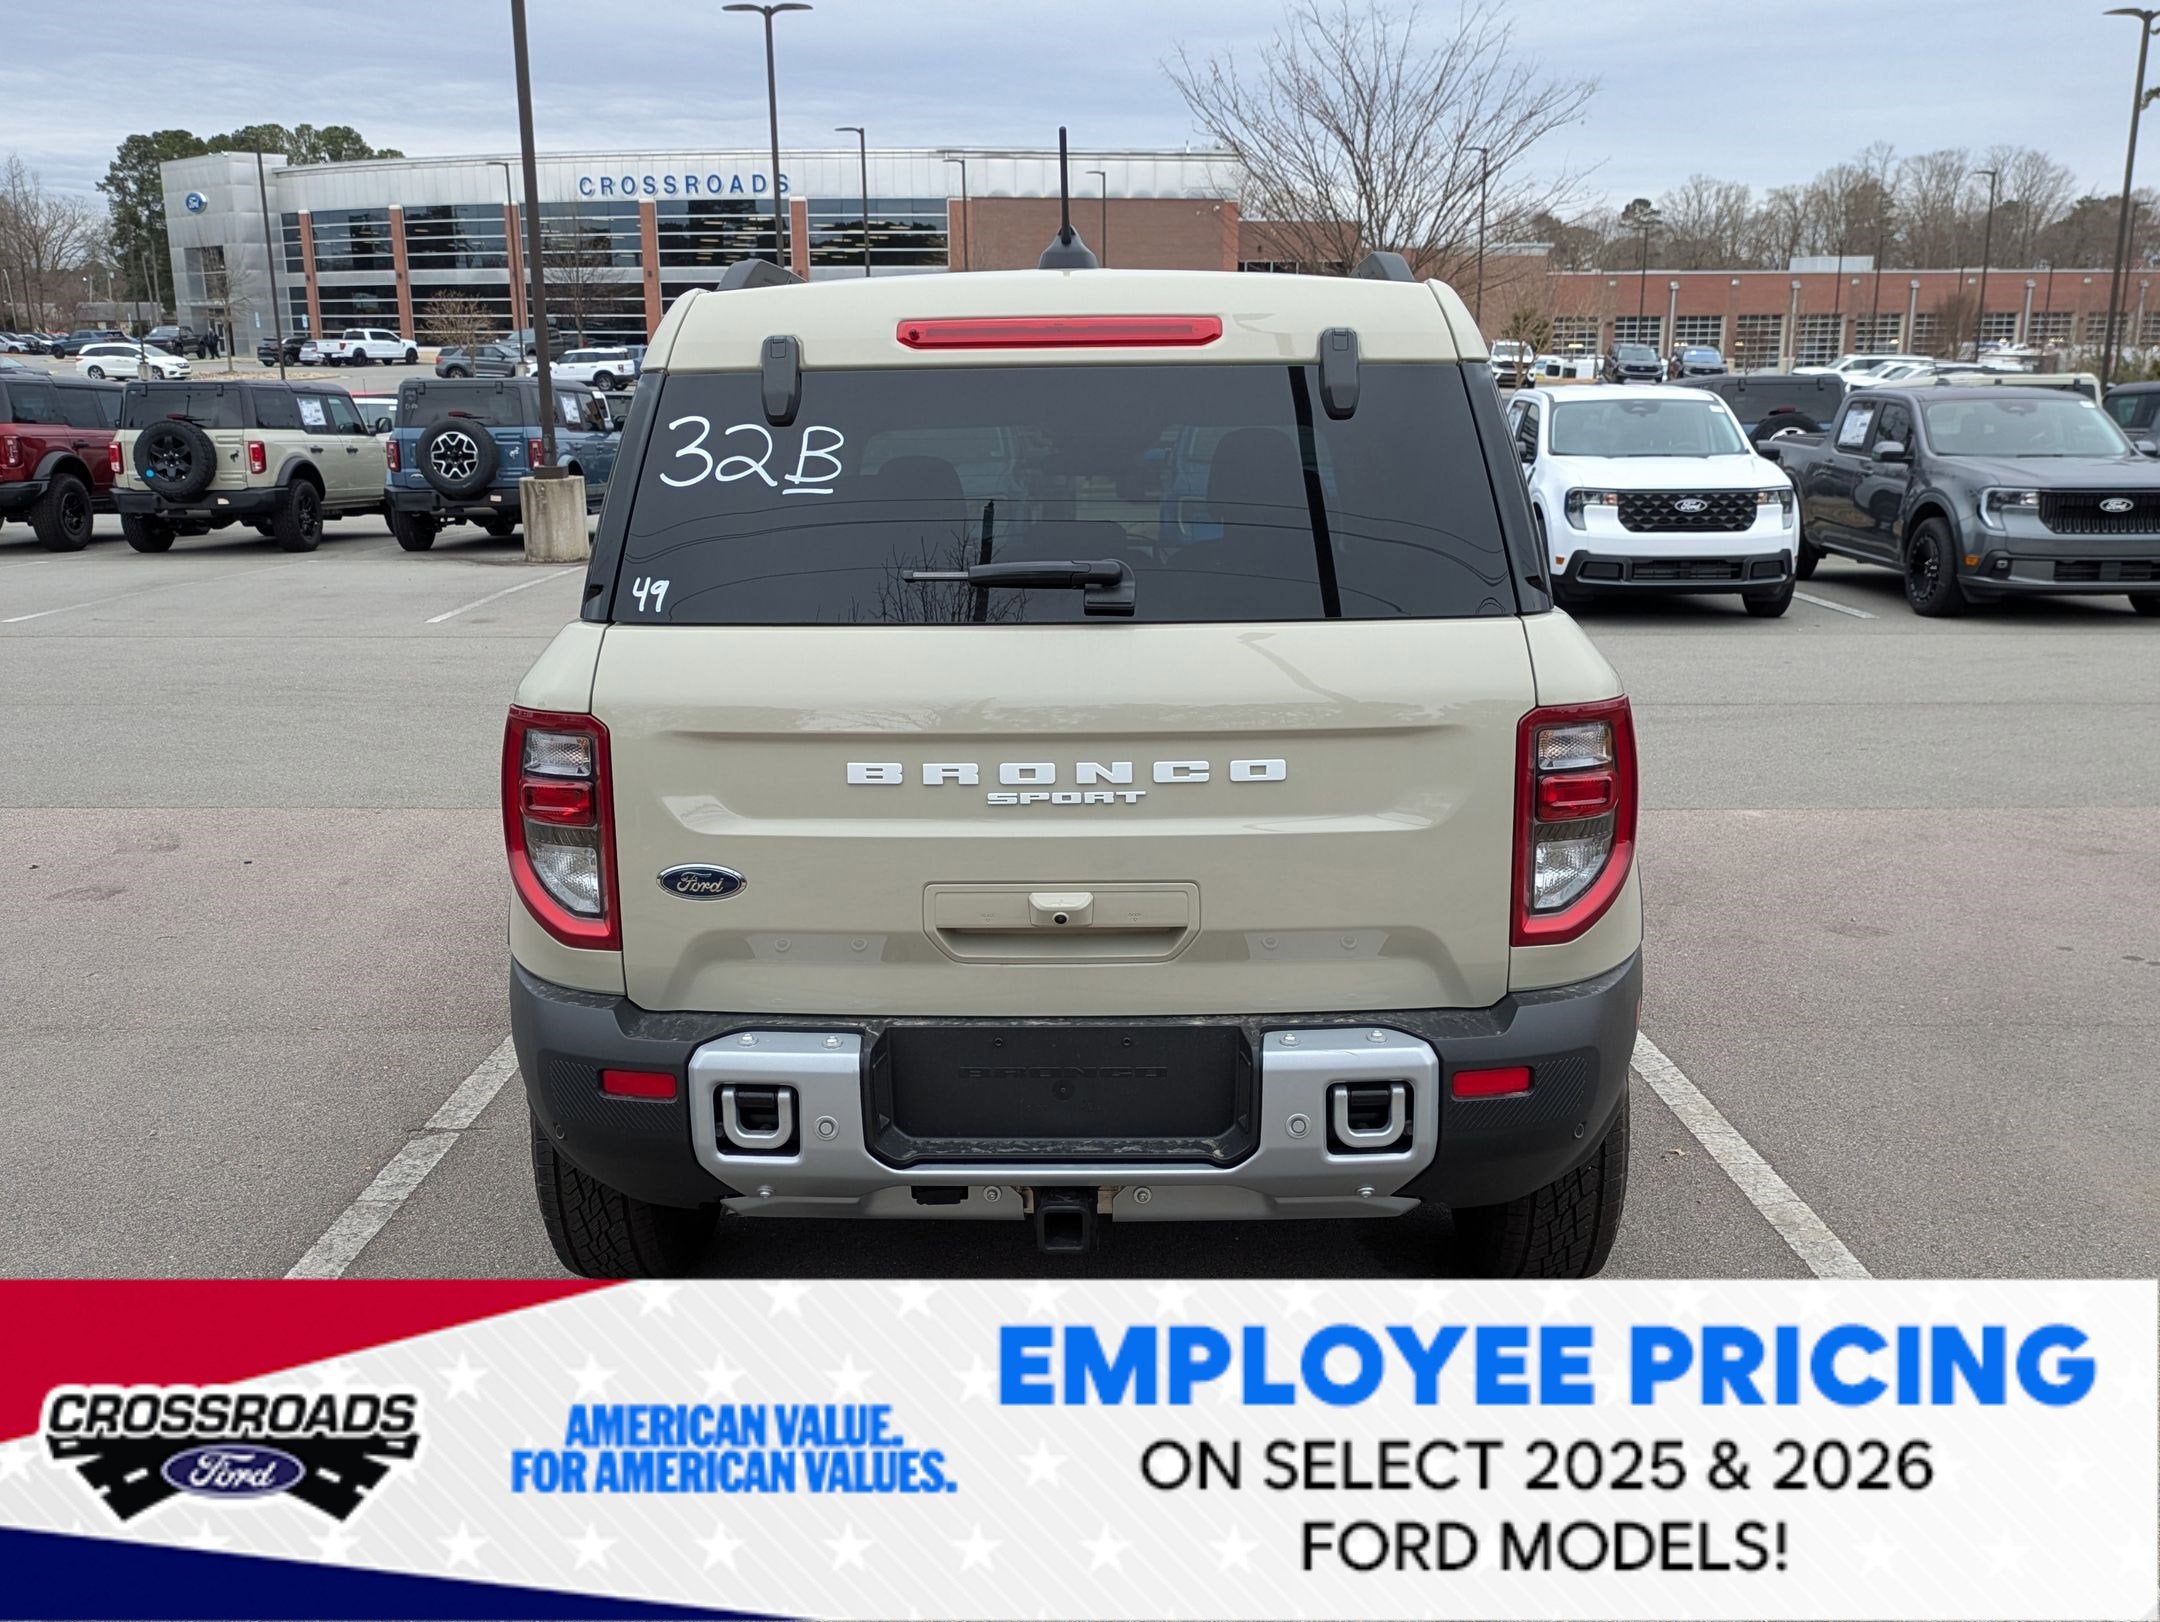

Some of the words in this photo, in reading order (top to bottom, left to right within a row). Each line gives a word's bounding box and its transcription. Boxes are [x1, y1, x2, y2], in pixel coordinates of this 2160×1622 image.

[579, 173, 790, 196] CROSSROADS
[632, 577, 670, 612] 49
[846, 759, 1287, 785] BRONCO
[987, 790, 1146, 805] SPORT
[676, 871, 724, 892] Ford
